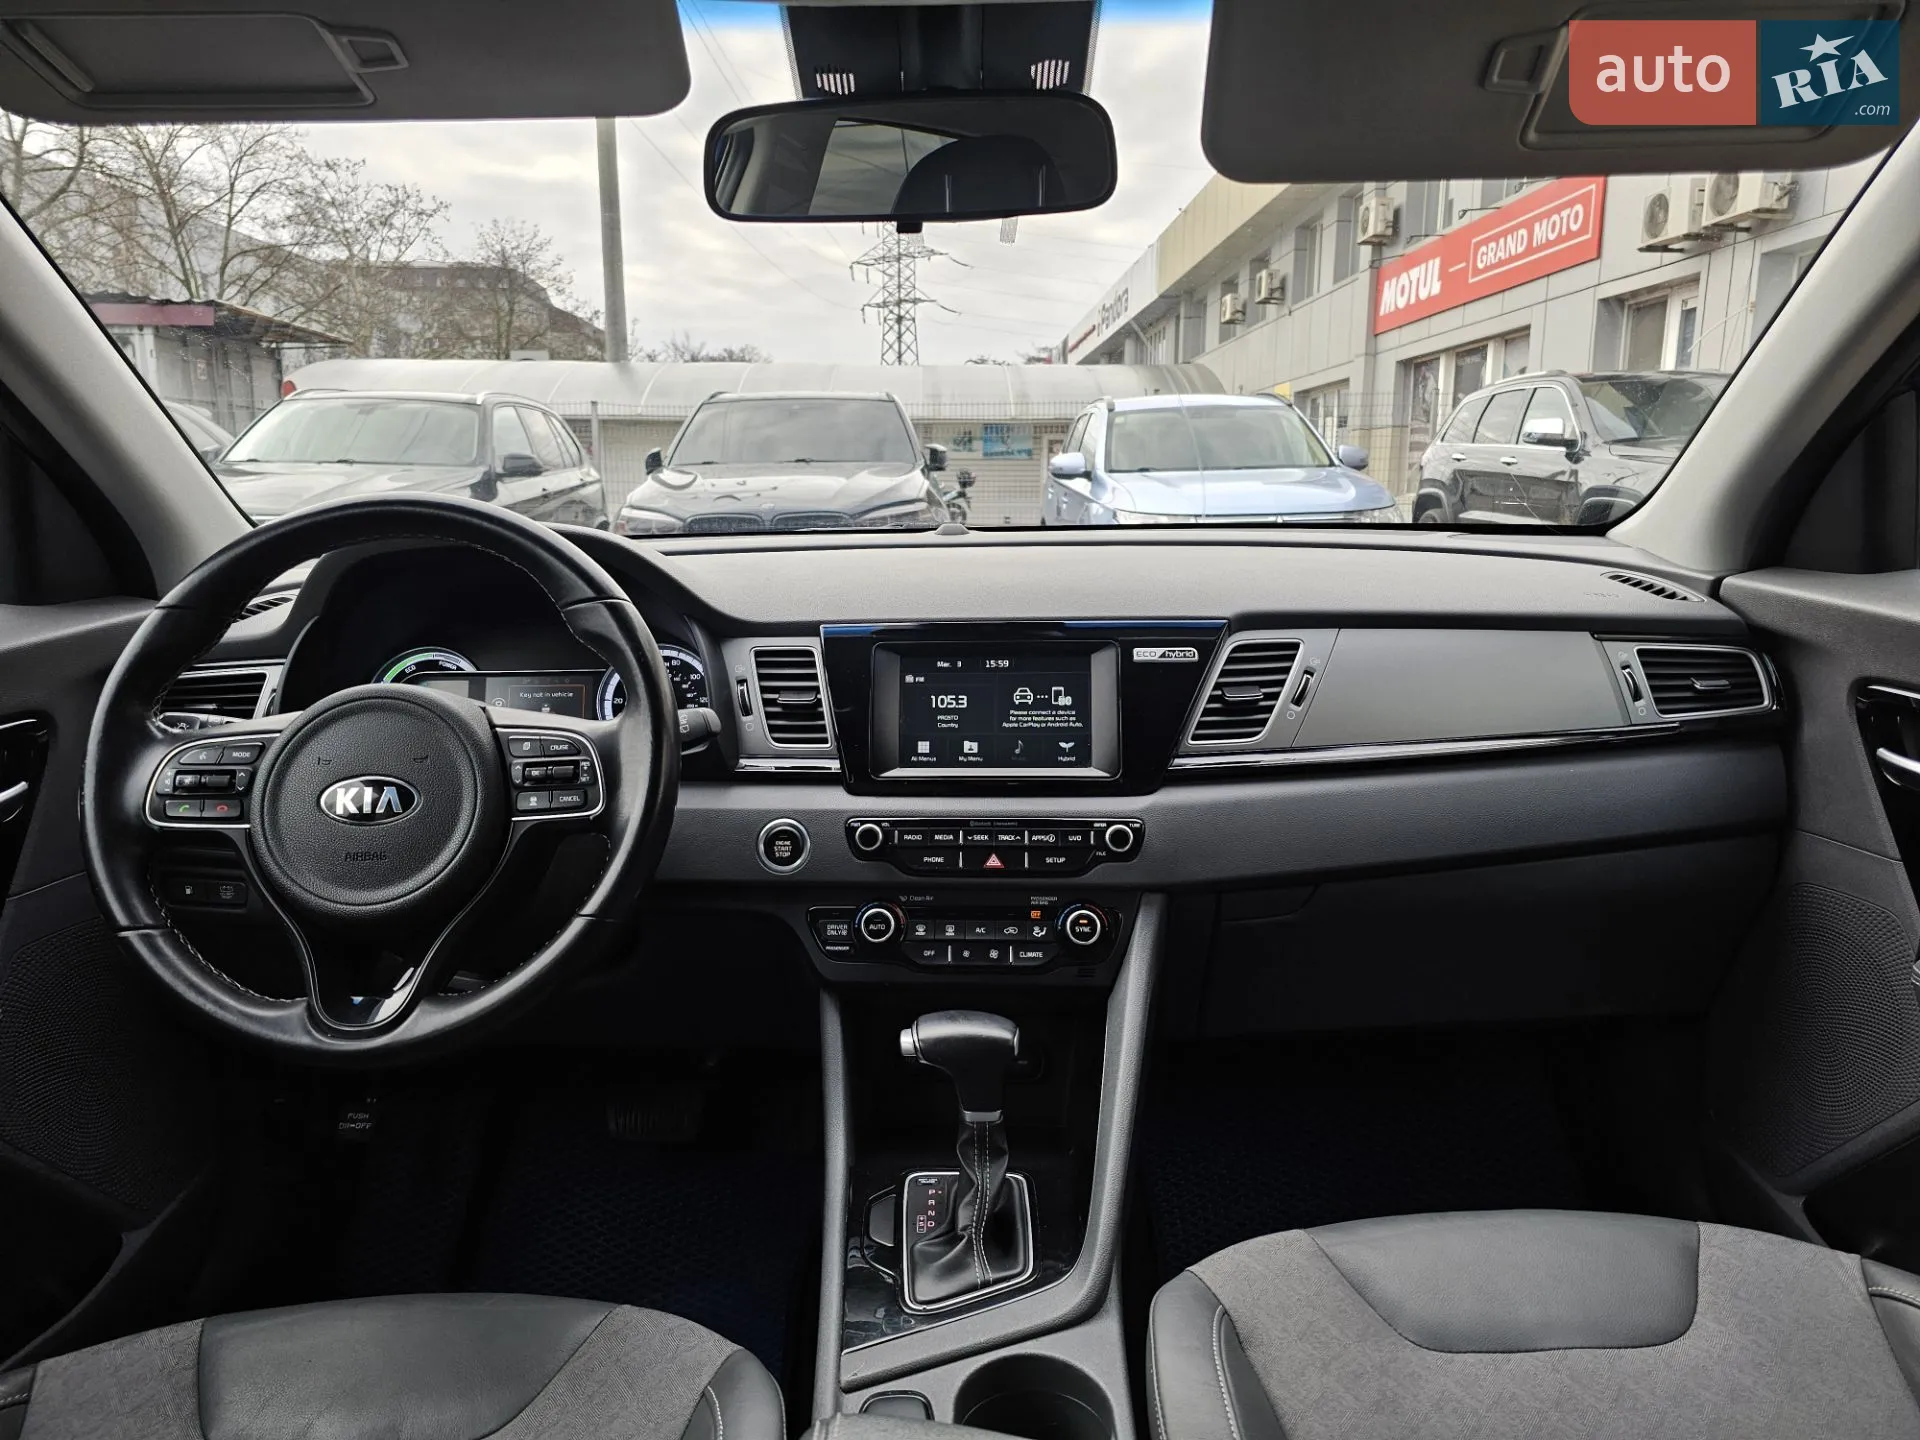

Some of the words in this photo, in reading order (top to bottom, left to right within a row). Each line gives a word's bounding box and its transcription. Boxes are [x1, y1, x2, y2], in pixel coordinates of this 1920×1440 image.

[1379, 257, 1442, 317] MOTUL
[1476, 228, 1528, 270] GRAND
[1533, 204, 1584, 247] MOTO
[1166, 650, 1194, 658] hybrid
[404, 664, 416, 674] ECO
[438, 660, 457, 670] POWER
[930, 694, 968, 708] 105.3
[336, 786, 402, 814] KIA
[345, 852, 387, 861] AIRBAG
